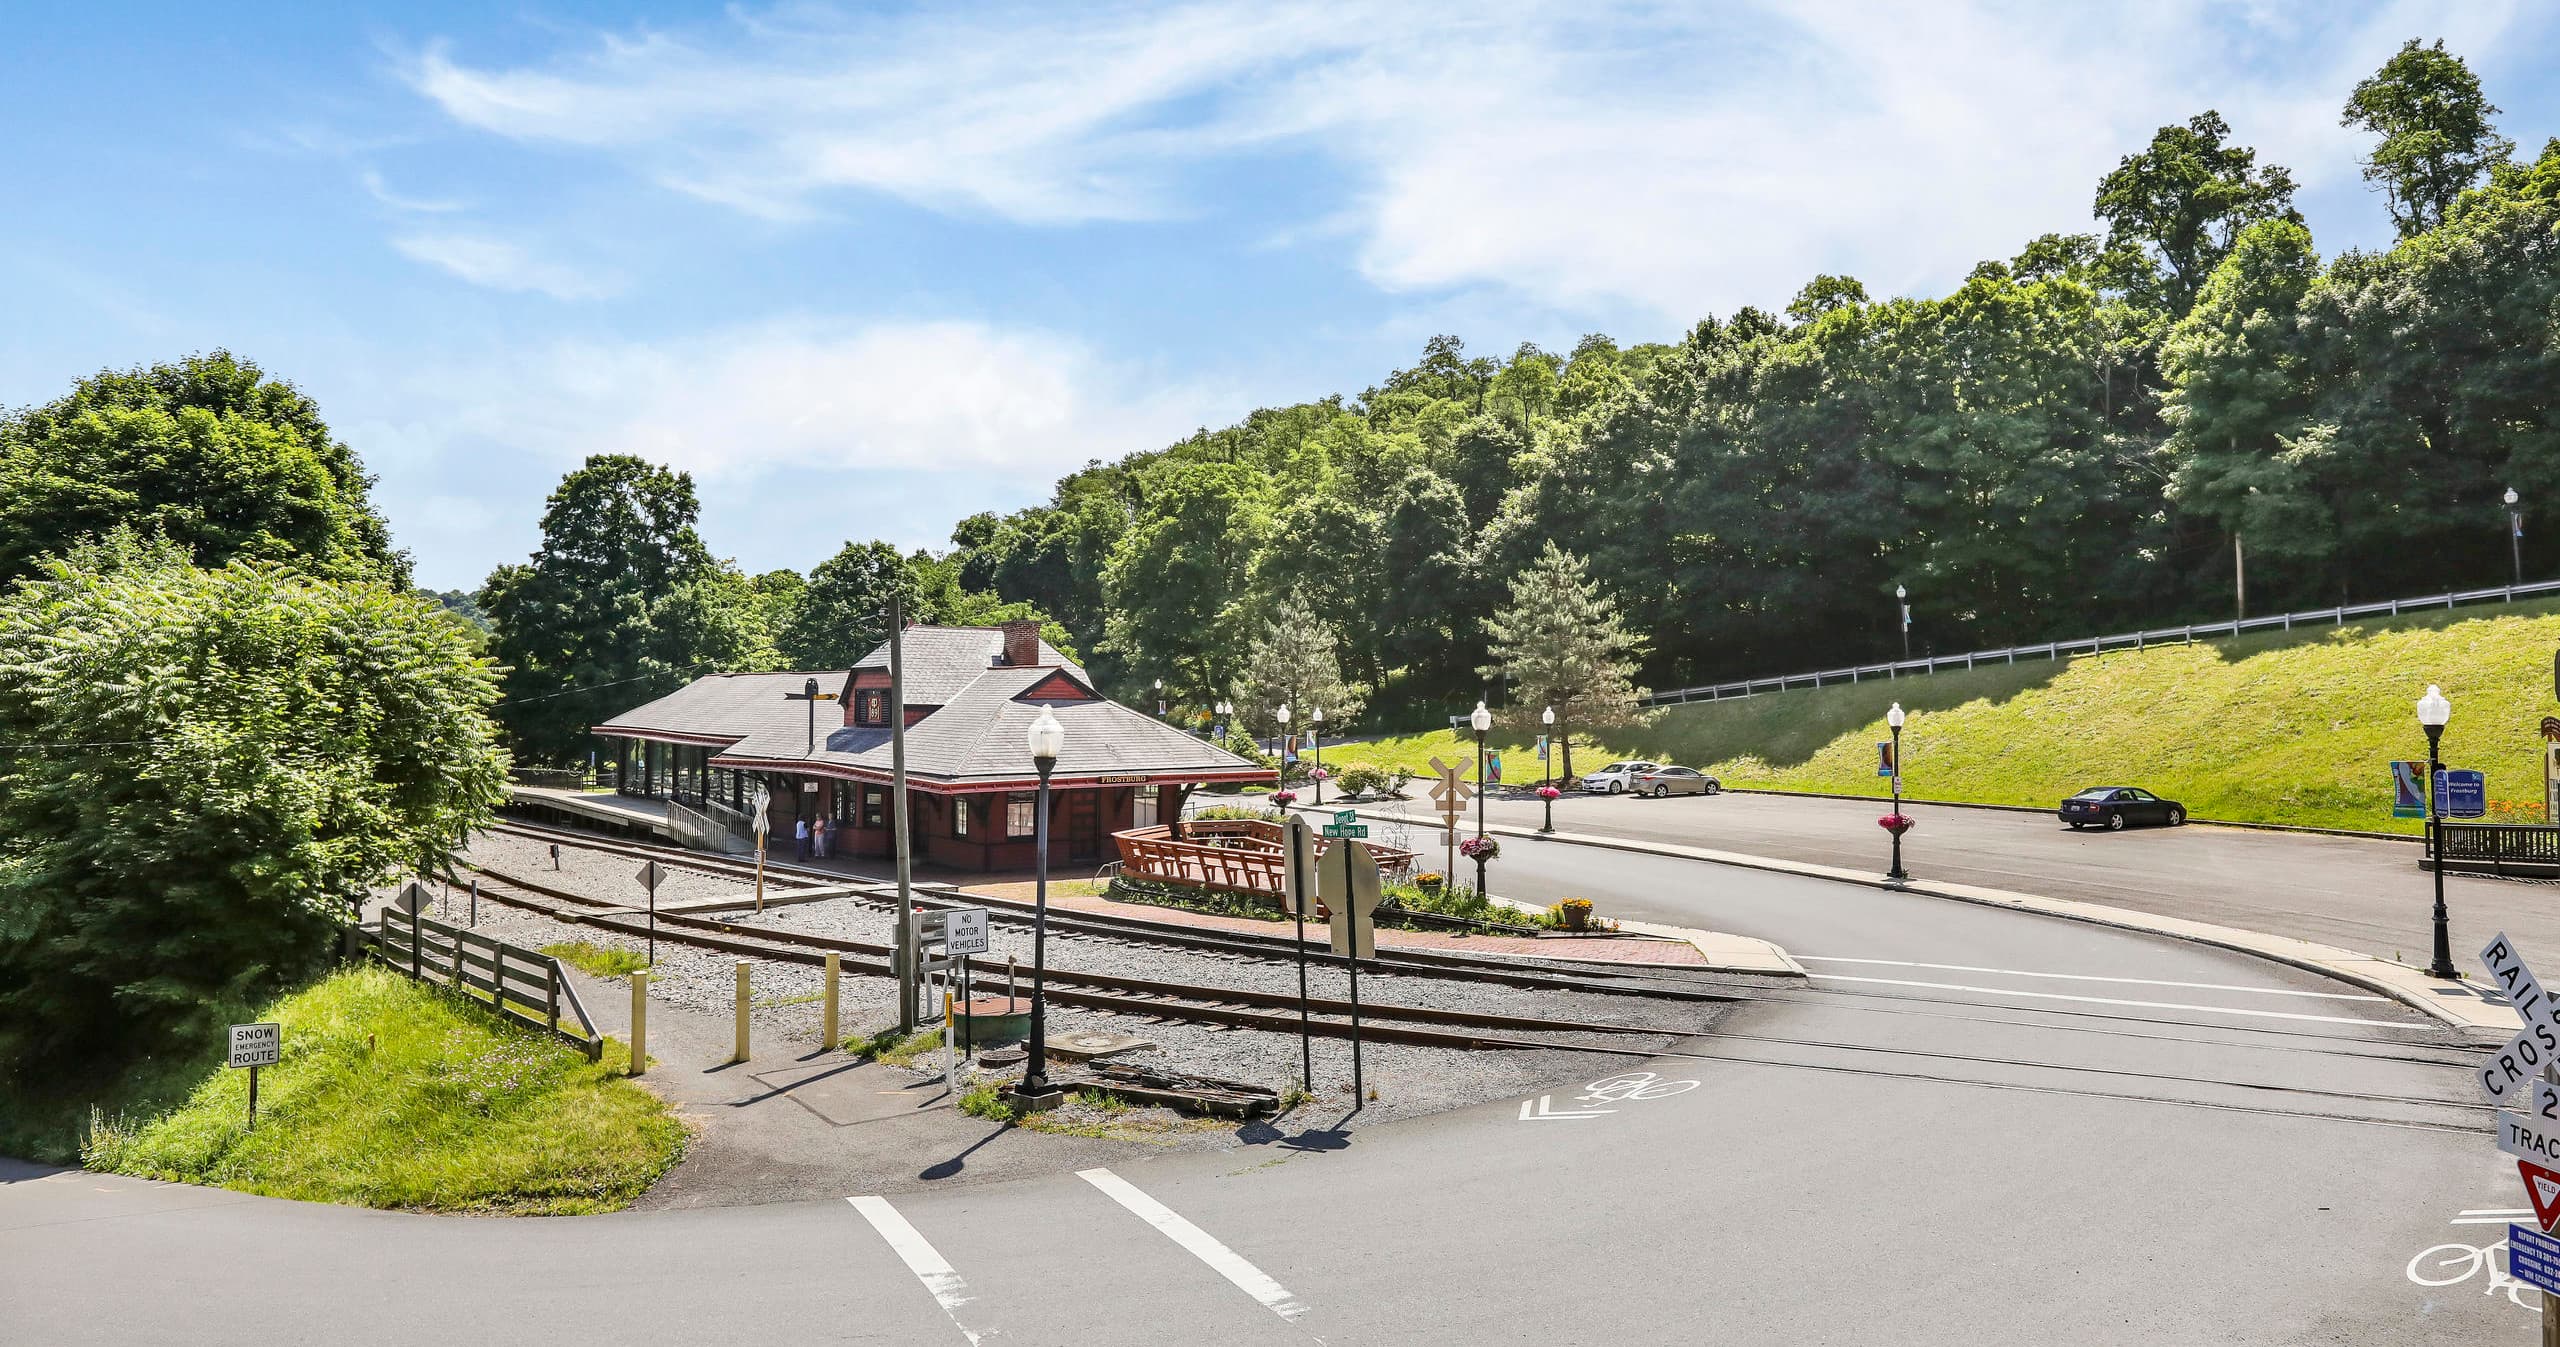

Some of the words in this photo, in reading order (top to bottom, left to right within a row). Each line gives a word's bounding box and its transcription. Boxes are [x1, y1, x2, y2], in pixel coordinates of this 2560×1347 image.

[1101, 775, 1146, 783] FROSTBURG
[1349, 811, 1355, 821] St
[1324, 826, 1339, 837] New
[1340, 825, 1355, 838] Hope
[1357, 826, 1366, 837] Rd
[961, 914, 972, 924] NO
[955, 926, 979, 937] MOTOR
[950, 938, 985, 950] VEHICLES
[2486, 940, 2540, 1022] RAIL
[236, 1028, 274, 1041] SNOW
[235, 1041, 275, 1051] EMERGENCY
[234, 1050, 275, 1064] ROUTE
[2541, 1089, 2558, 1120] 2
[2537, 1181, 2556, 1194] YIELD
[2510, 1239, 2536, 1257] EMERGENCY
[2518, 1231, 2535, 1245] REPORT
[2535, 1236, 2560, 1254] PROBLEMS
[2534, 1273, 2553, 1288] SCENIC
